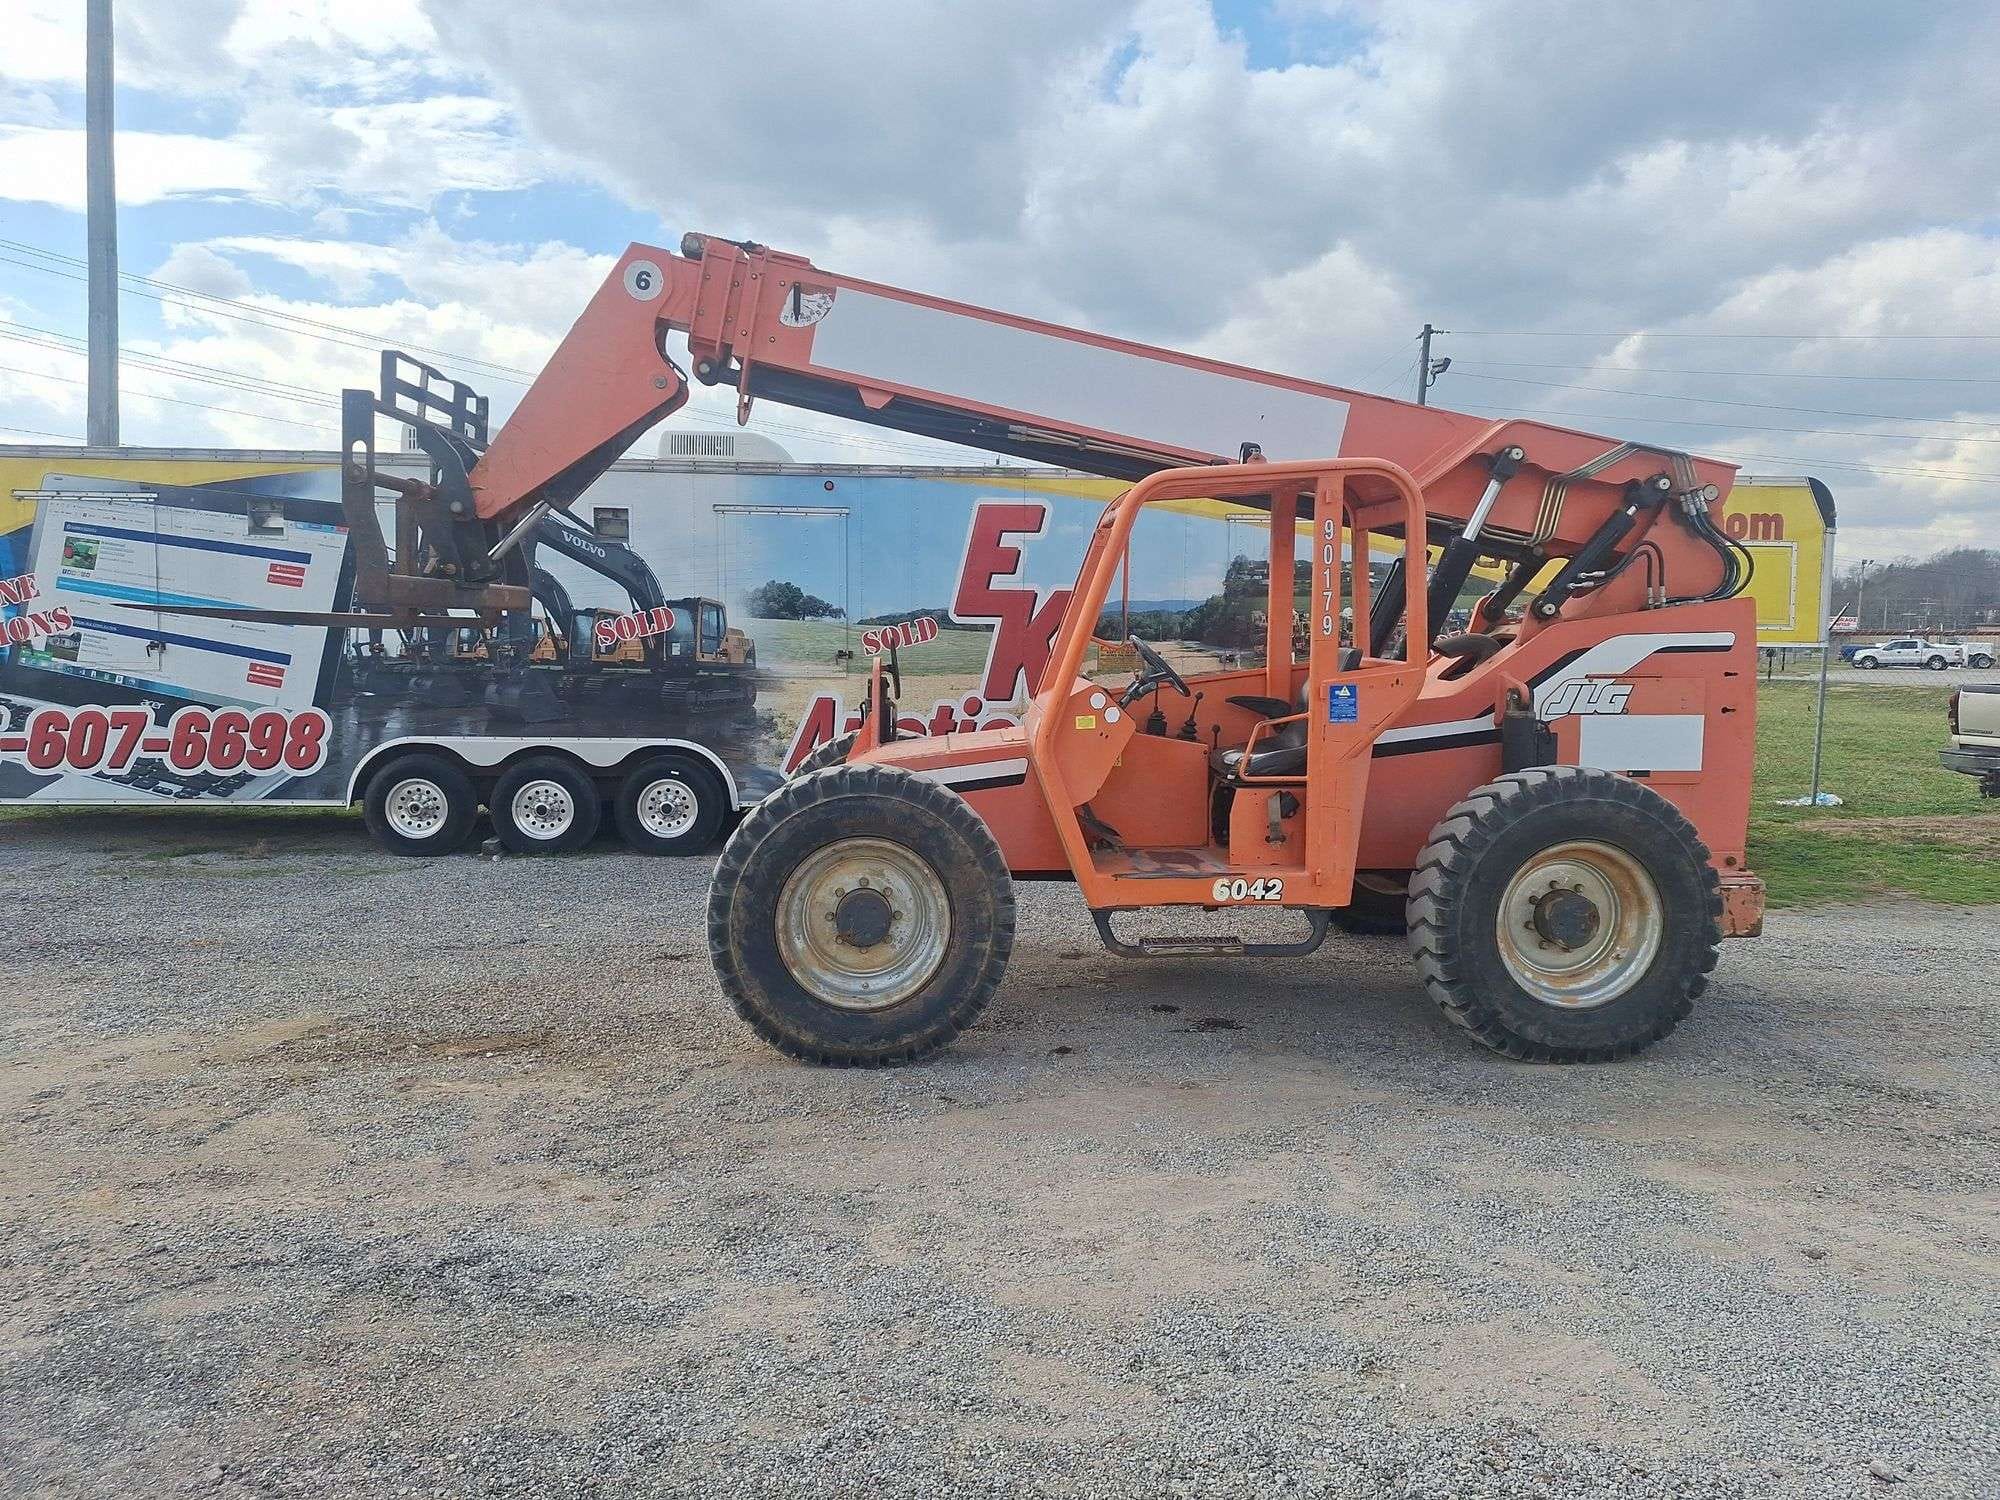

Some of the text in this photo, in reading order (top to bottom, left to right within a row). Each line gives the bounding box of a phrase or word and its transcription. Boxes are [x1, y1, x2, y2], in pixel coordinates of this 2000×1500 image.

[635, 270, 652, 290] 6
[561, 530, 606, 559] VOLVO
[1321, 518, 1335, 636] 90179
[595, 606, 675, 646] SOLD
[861, 616, 939, 656] SOLD
[140, 698, 166, 710] acer
[1545, 683, 1635, 715] JLG
[1212, 878, 1284, 902] 6042
